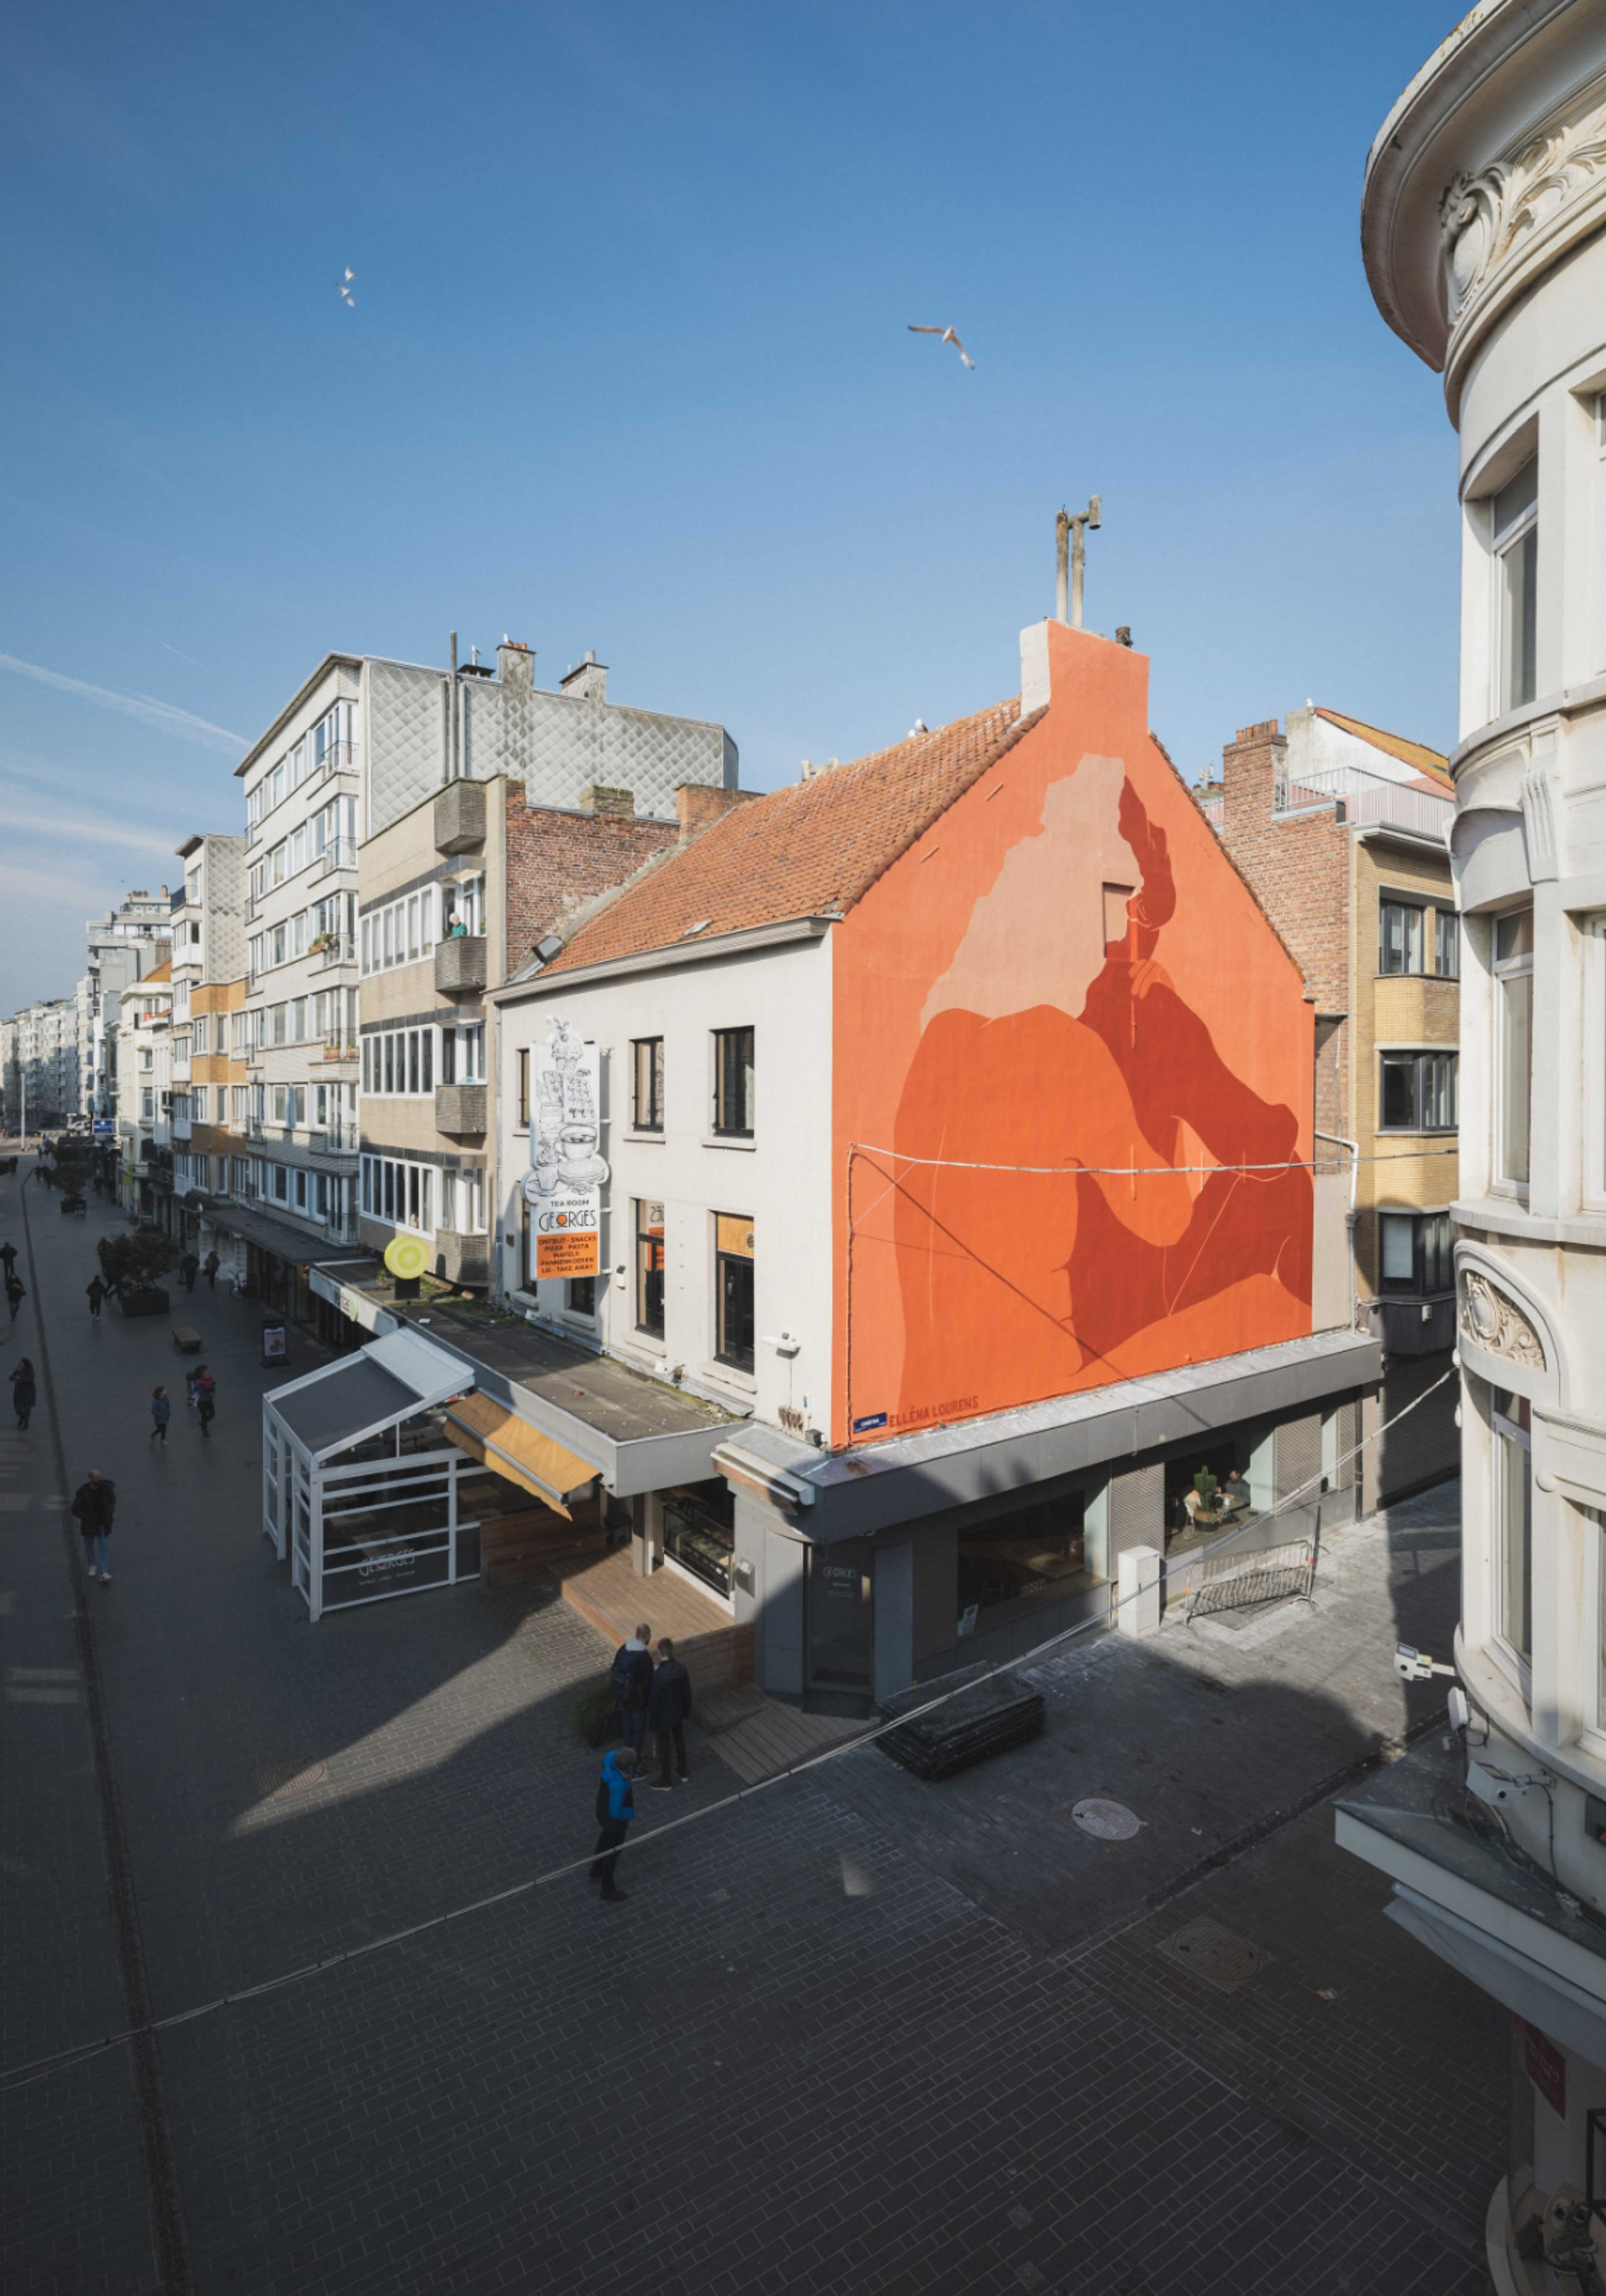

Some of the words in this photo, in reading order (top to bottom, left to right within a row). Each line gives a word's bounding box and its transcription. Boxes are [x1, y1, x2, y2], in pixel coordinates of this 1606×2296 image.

[538, 1210, 597, 1232] GEORGES
[889, 1405, 930, 1428] ELLÉNA
[932, 1395, 979, 1418] LOURENS
